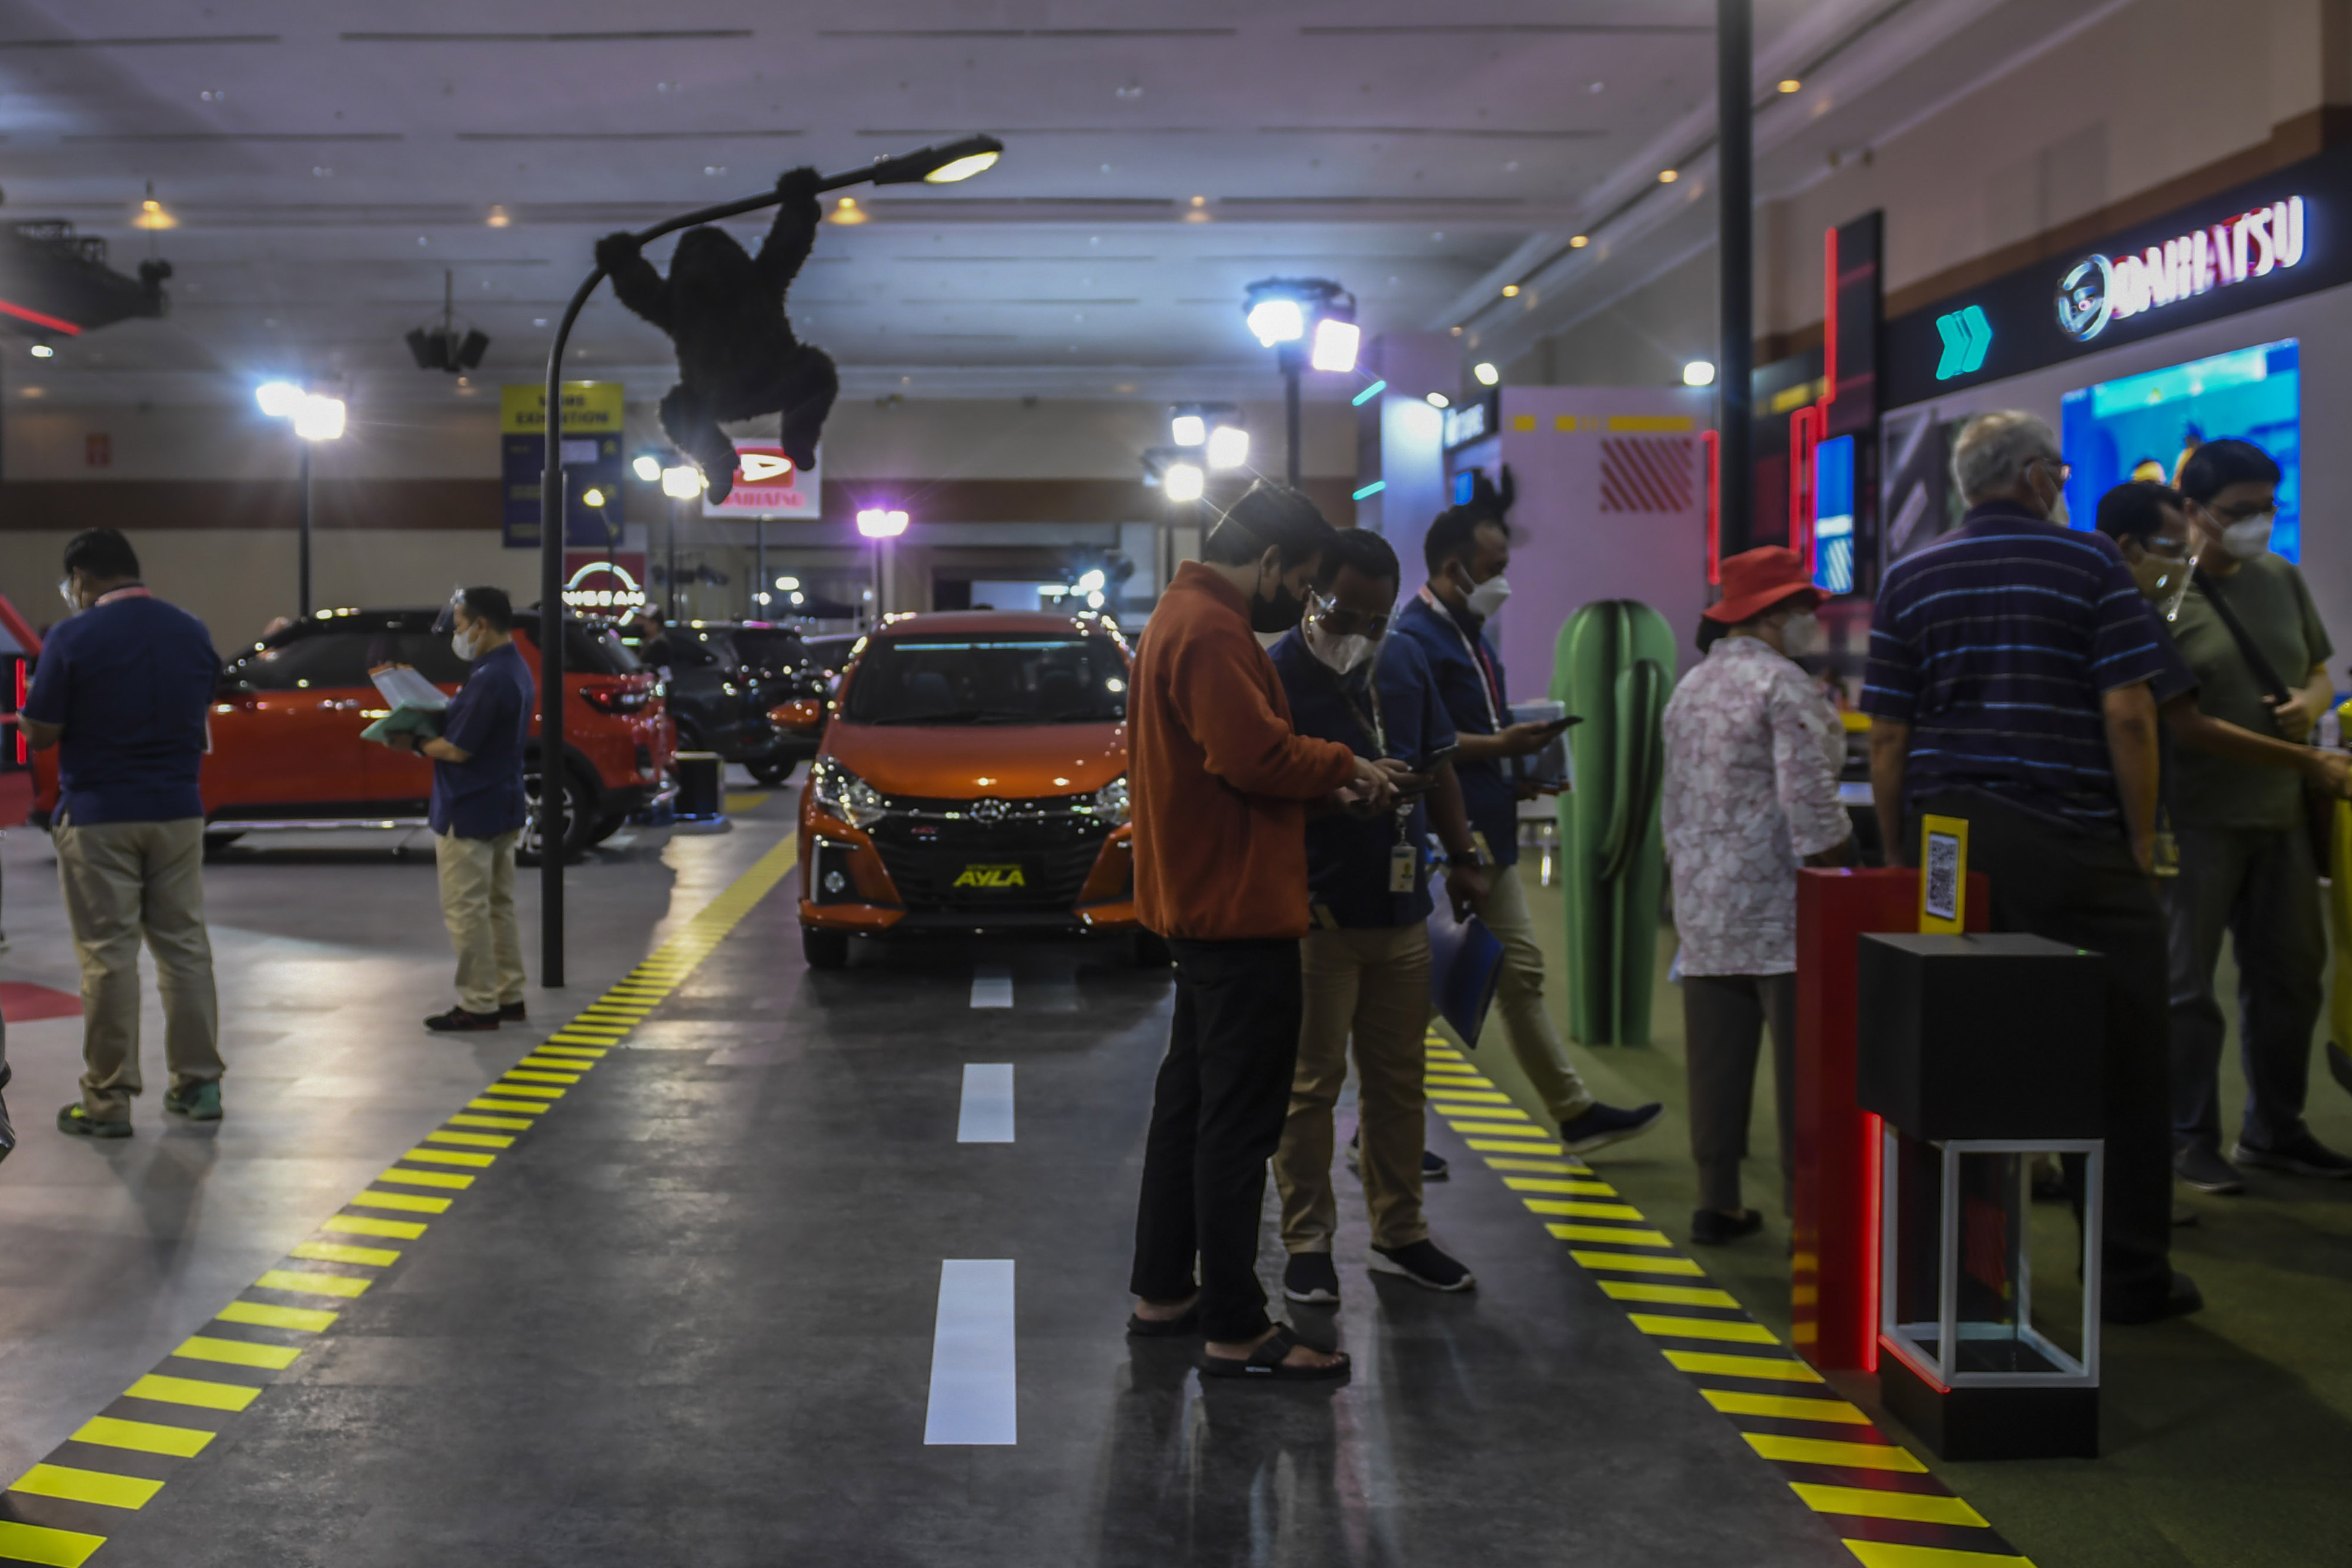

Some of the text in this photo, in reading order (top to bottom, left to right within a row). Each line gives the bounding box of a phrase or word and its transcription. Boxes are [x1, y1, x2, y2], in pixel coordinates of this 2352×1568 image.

[2112, 195, 2304, 320] DAIHATSU
[721, 491, 807, 509] AIHATSU
[562, 590, 646, 607] NISSAN
[953, 869, 1025, 887] AYLA
